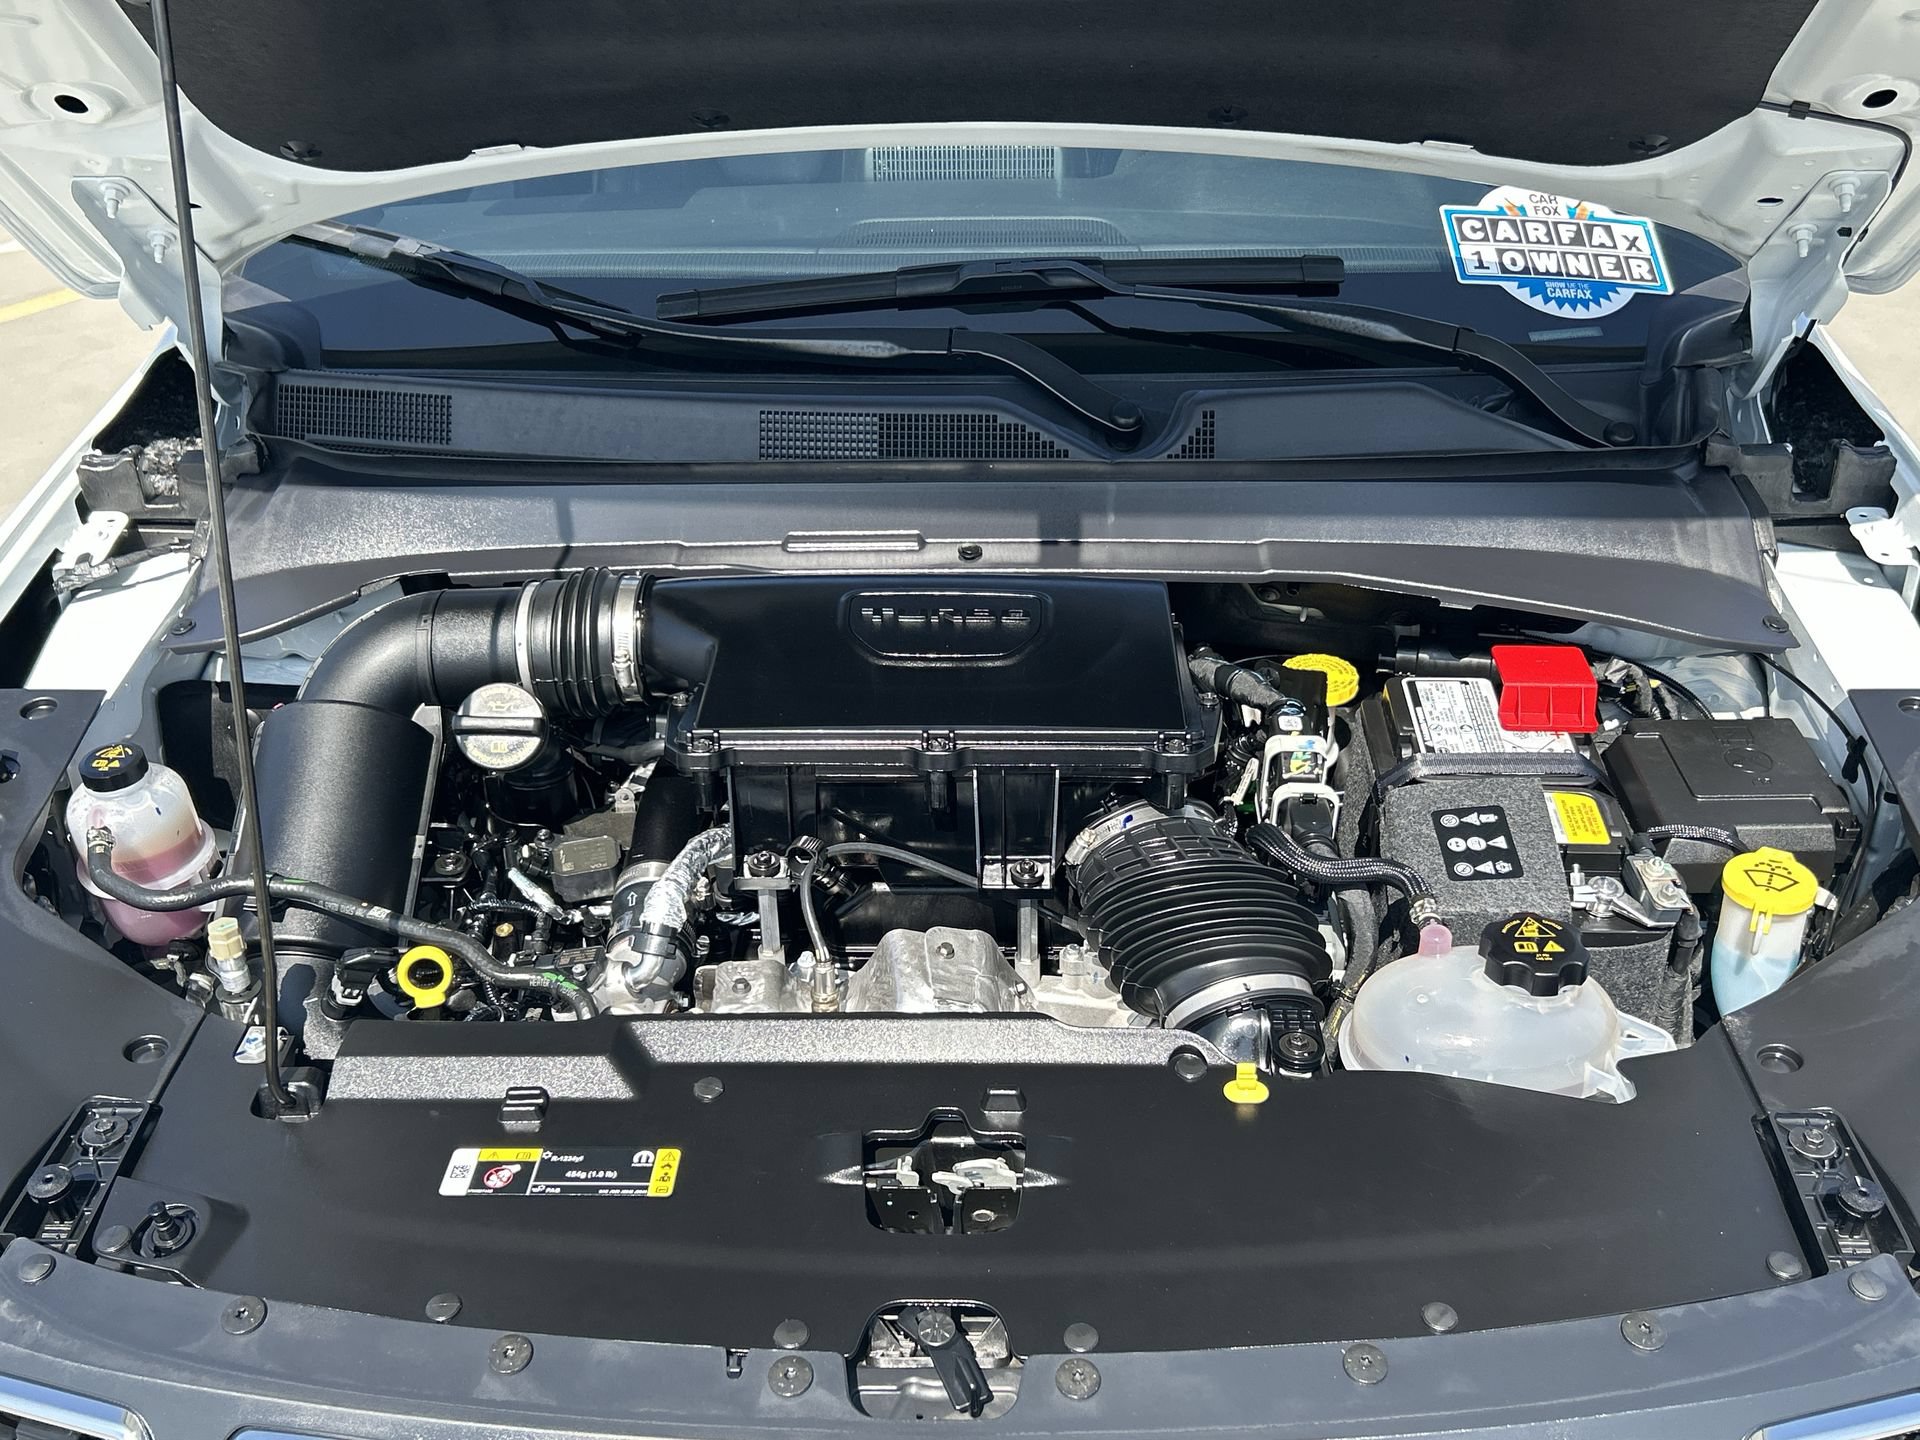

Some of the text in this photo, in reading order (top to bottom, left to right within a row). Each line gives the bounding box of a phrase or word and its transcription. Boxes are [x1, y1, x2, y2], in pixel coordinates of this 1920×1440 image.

[1533, 206, 1561, 216] FOX
[1461, 219, 1644, 252] CARFAX
[1470, 250, 1653, 281] 1 OWNER
[1544, 281, 1565, 289] SHOW
[1547, 288, 1593, 300] CARFAX
